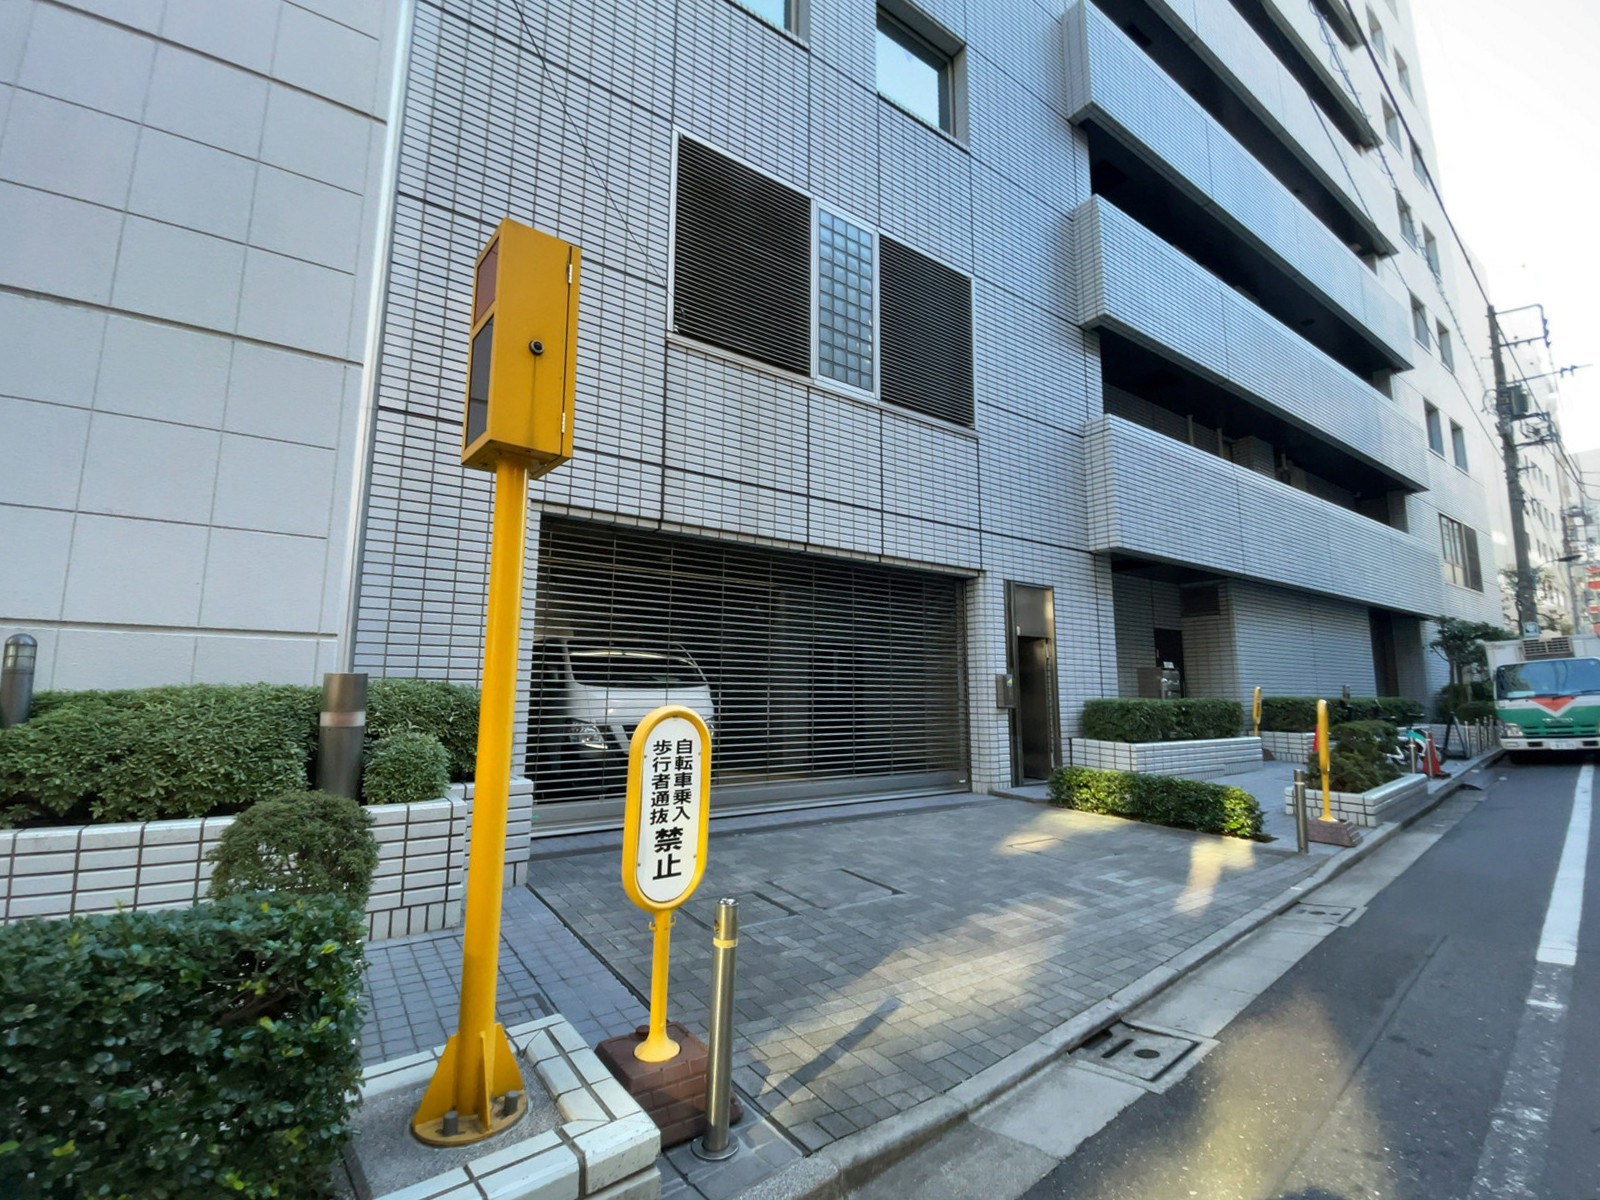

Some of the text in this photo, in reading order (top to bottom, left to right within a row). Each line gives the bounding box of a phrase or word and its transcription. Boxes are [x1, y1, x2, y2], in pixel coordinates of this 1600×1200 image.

[650, 739, 672, 826] 歩行者通抜
[672, 738, 693, 821] 自転車乗入
[653, 827, 683, 880] 禁止
